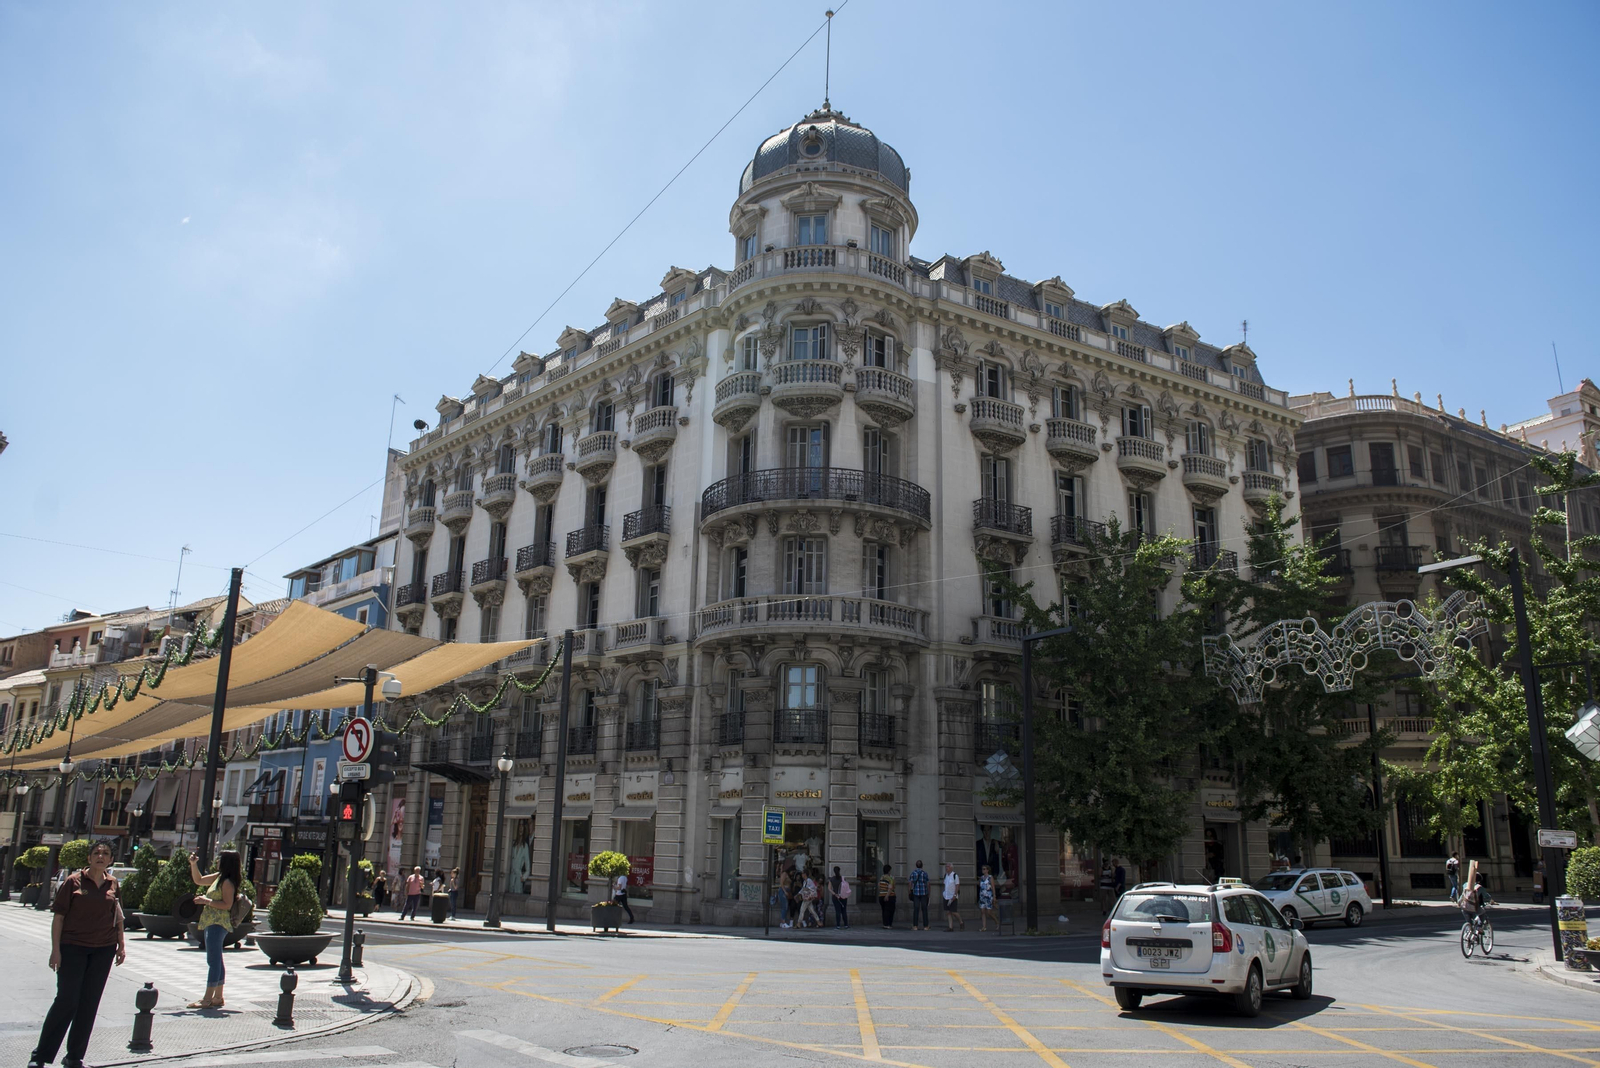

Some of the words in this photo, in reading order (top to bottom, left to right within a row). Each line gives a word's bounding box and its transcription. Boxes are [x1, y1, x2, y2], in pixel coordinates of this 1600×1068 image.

[775, 790, 822, 798] cortefiel
[571, 863, 588, 871] REBAJAS
[1142, 948, 1162, 956] 0023
[1165, 949, 1179, 958] JWZ
[1152, 959, 1166, 967] SP
